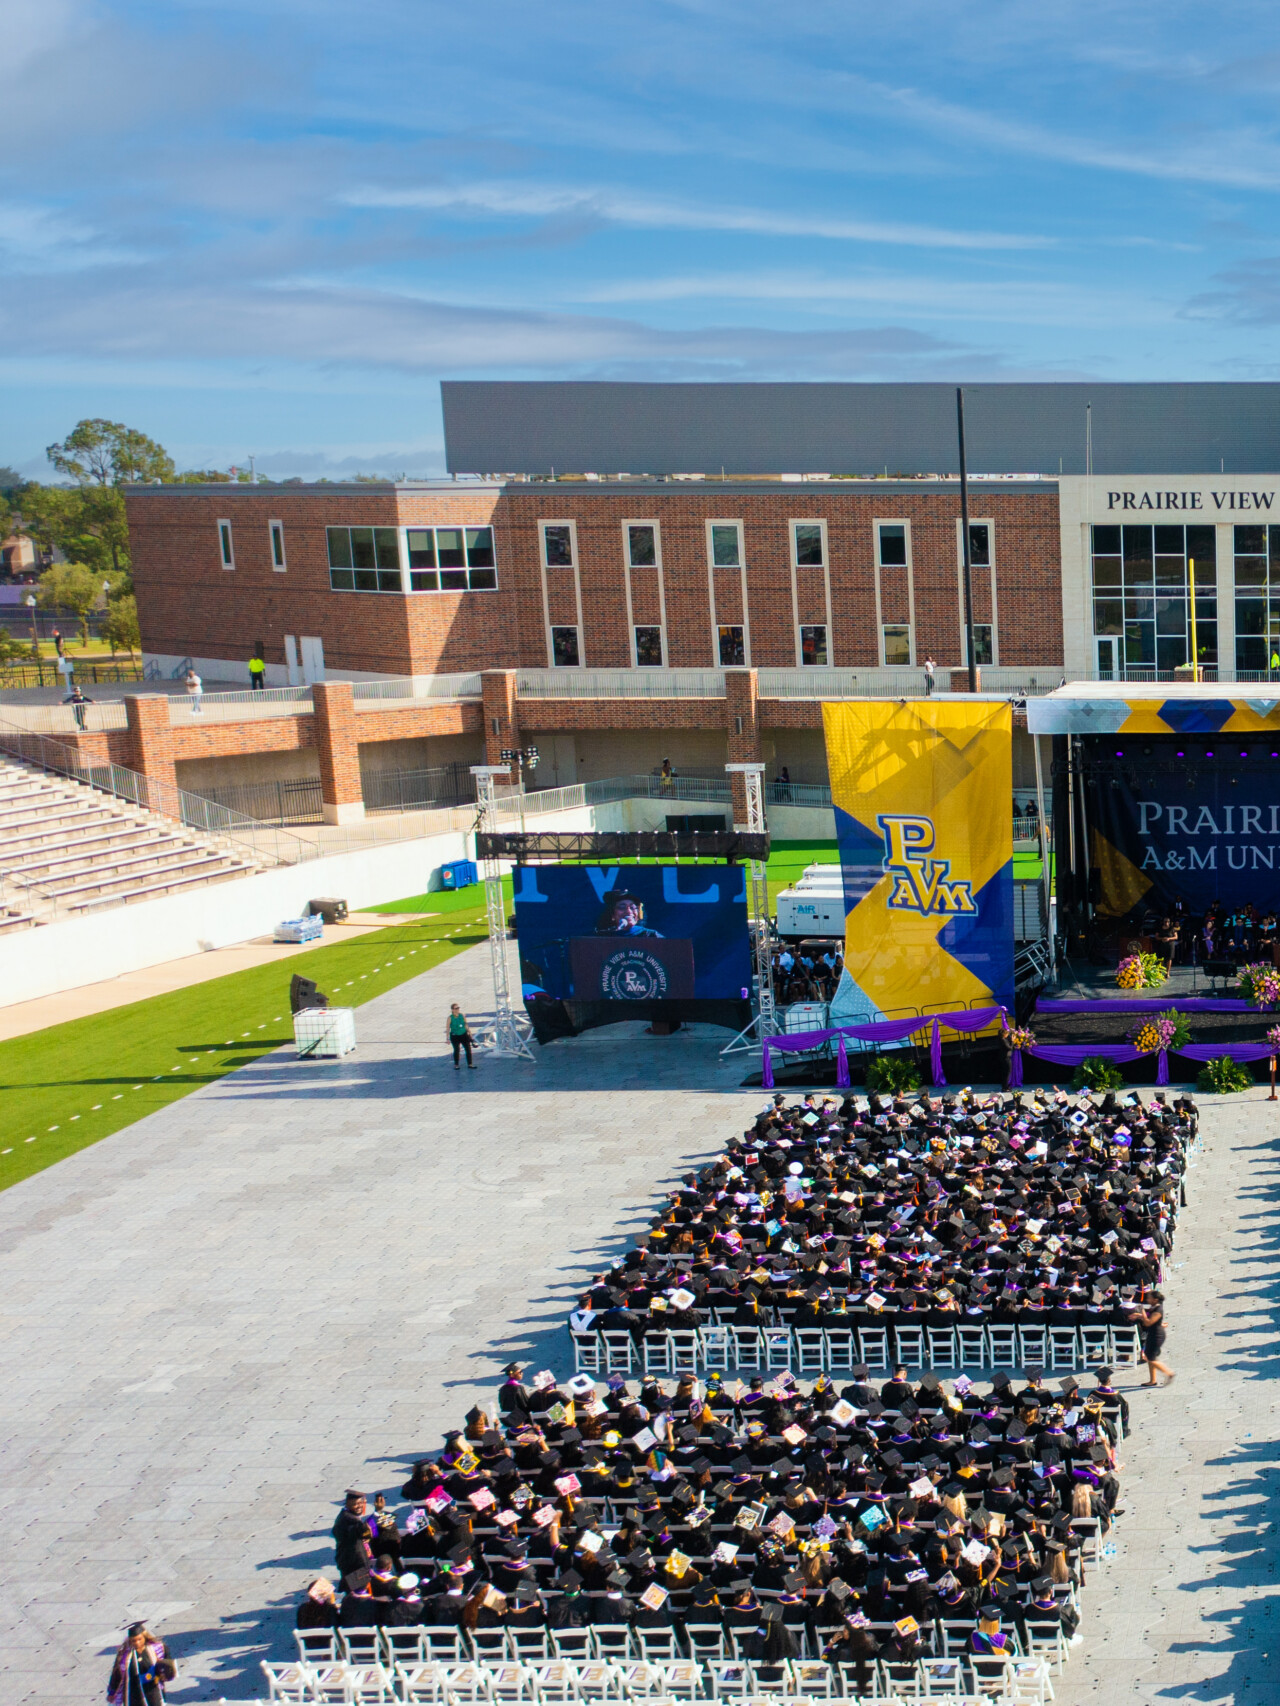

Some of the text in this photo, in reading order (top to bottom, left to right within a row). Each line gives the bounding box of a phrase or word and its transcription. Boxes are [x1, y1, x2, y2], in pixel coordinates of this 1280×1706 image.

[1107, 491, 1203, 510] PRAIRIE
[1210, 491, 1275, 510] VIEW
[1139, 845, 1218, 870] A&M
[797, 904, 816, 914] AIR
[610, 952, 625, 964] VIEW
